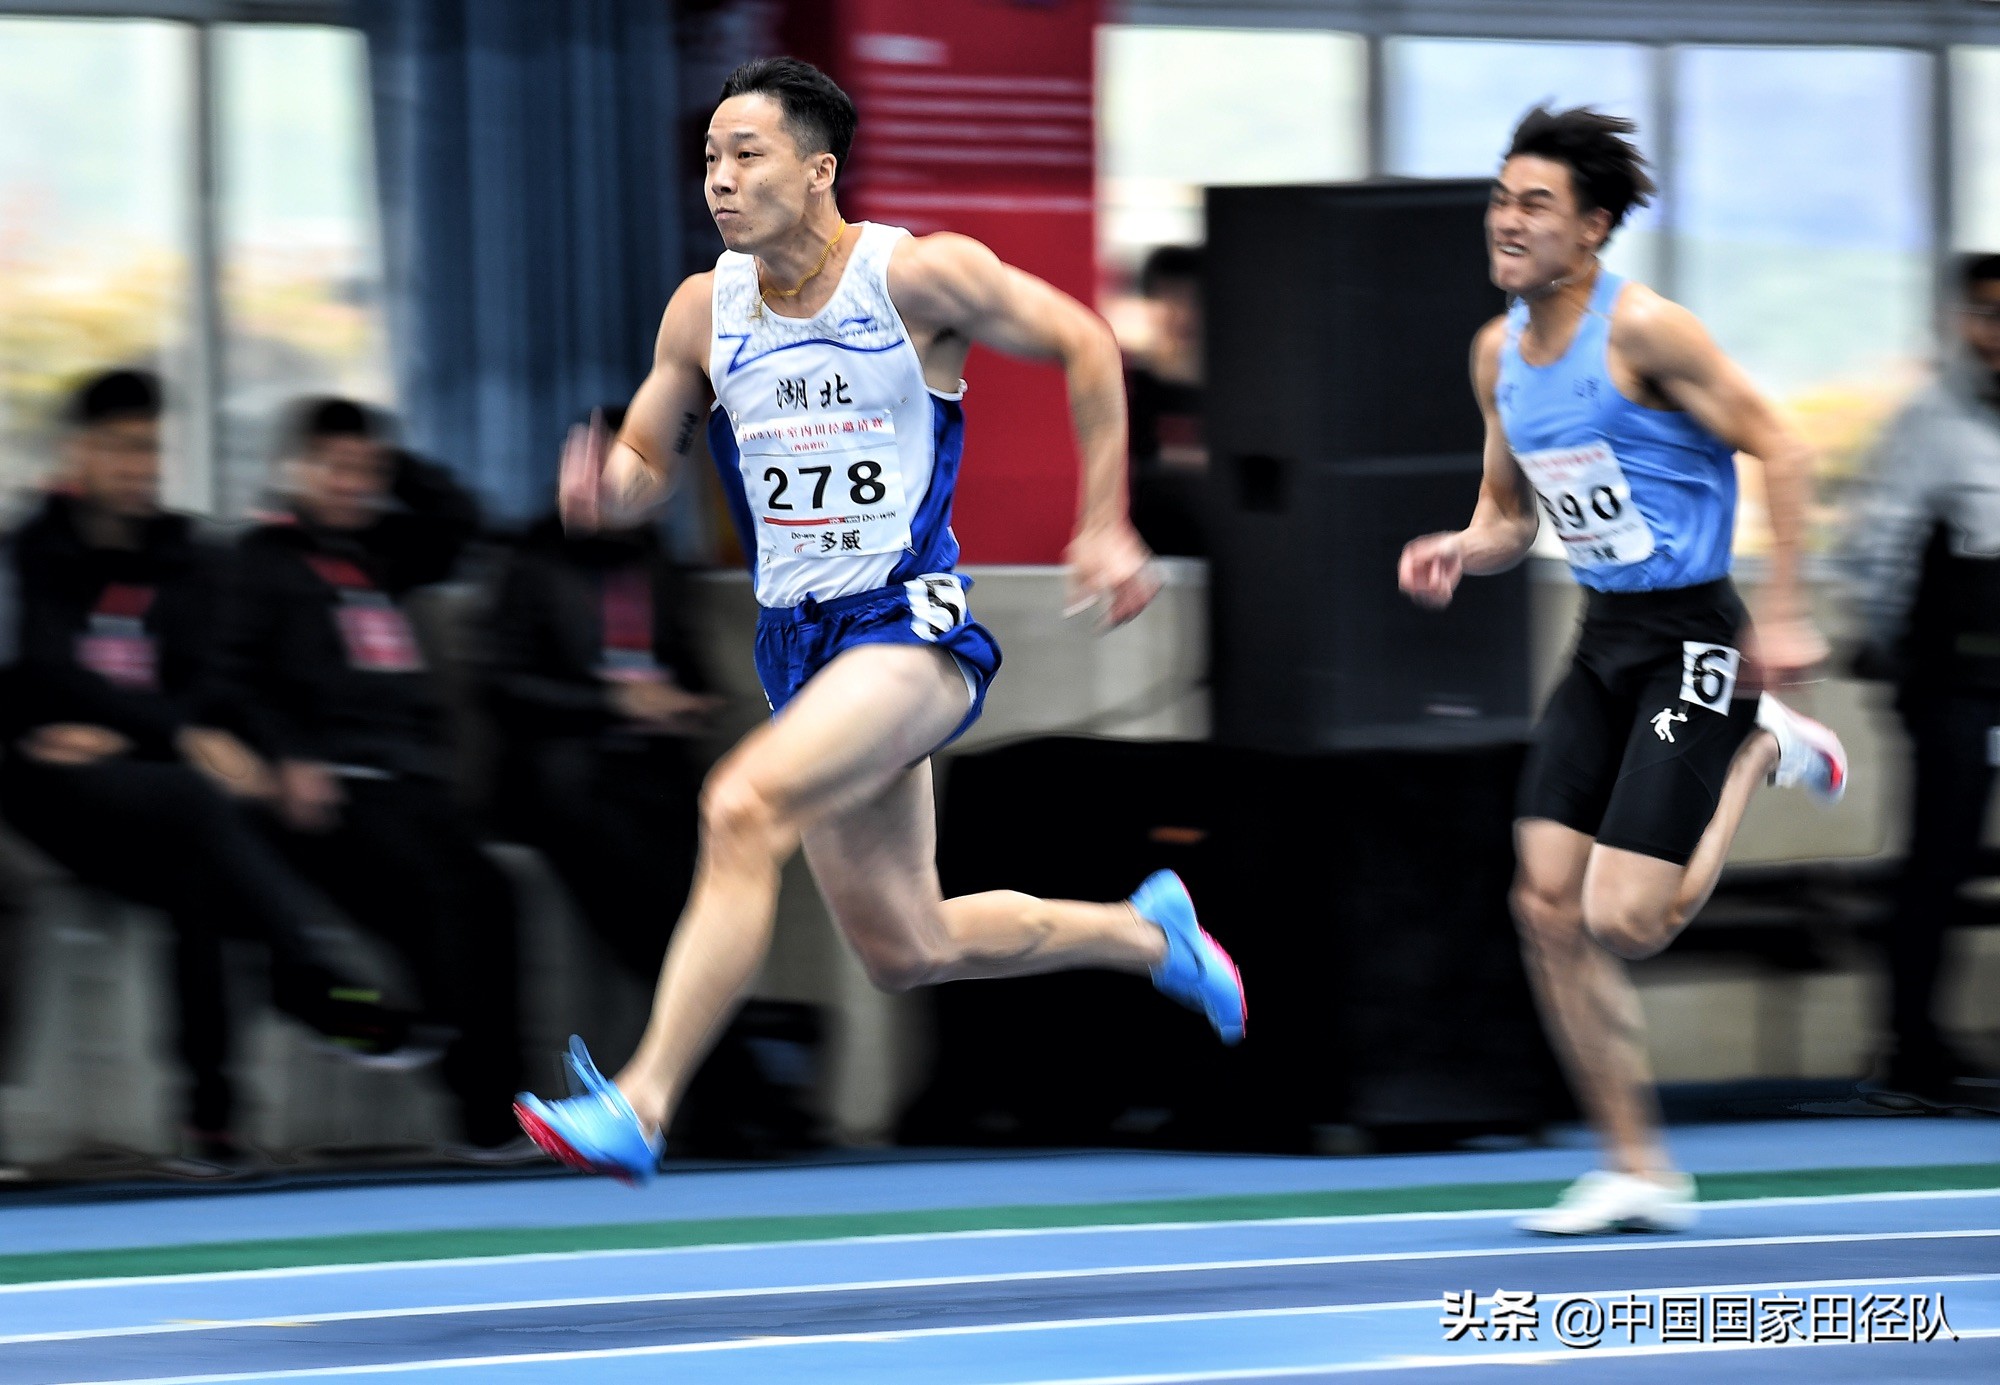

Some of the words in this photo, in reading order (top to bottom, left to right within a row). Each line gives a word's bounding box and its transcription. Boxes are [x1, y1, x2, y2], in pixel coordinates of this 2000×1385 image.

[776, 373, 852, 410] 湖北
[763, 460, 886, 511] 278
[820, 529, 862, 553] 多威
[1693, 649, 1730, 704] 6
